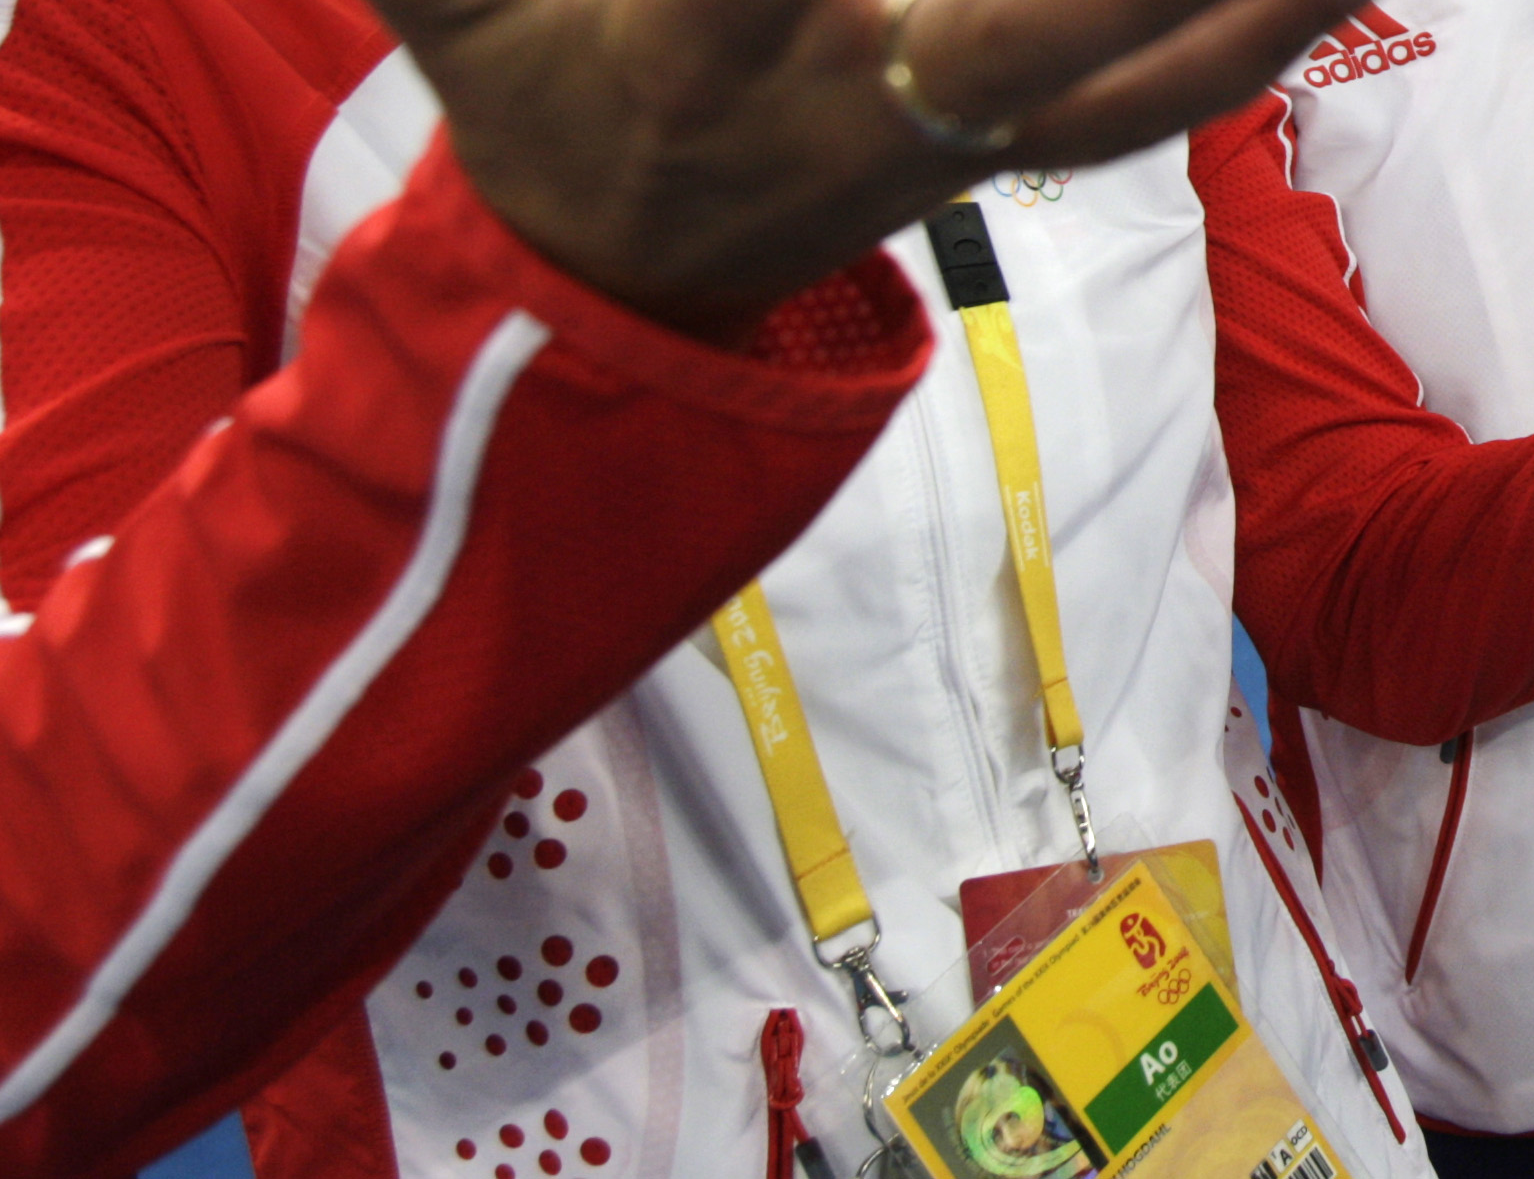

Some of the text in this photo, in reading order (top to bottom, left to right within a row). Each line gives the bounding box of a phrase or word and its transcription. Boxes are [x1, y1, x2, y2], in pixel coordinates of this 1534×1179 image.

[1303, 31, 1437, 88] adidas
[1016, 490, 1039, 560] Kodak
[727, 595, 788, 758] Beijing 200
[1139, 1040, 1179, 1087] Ao
